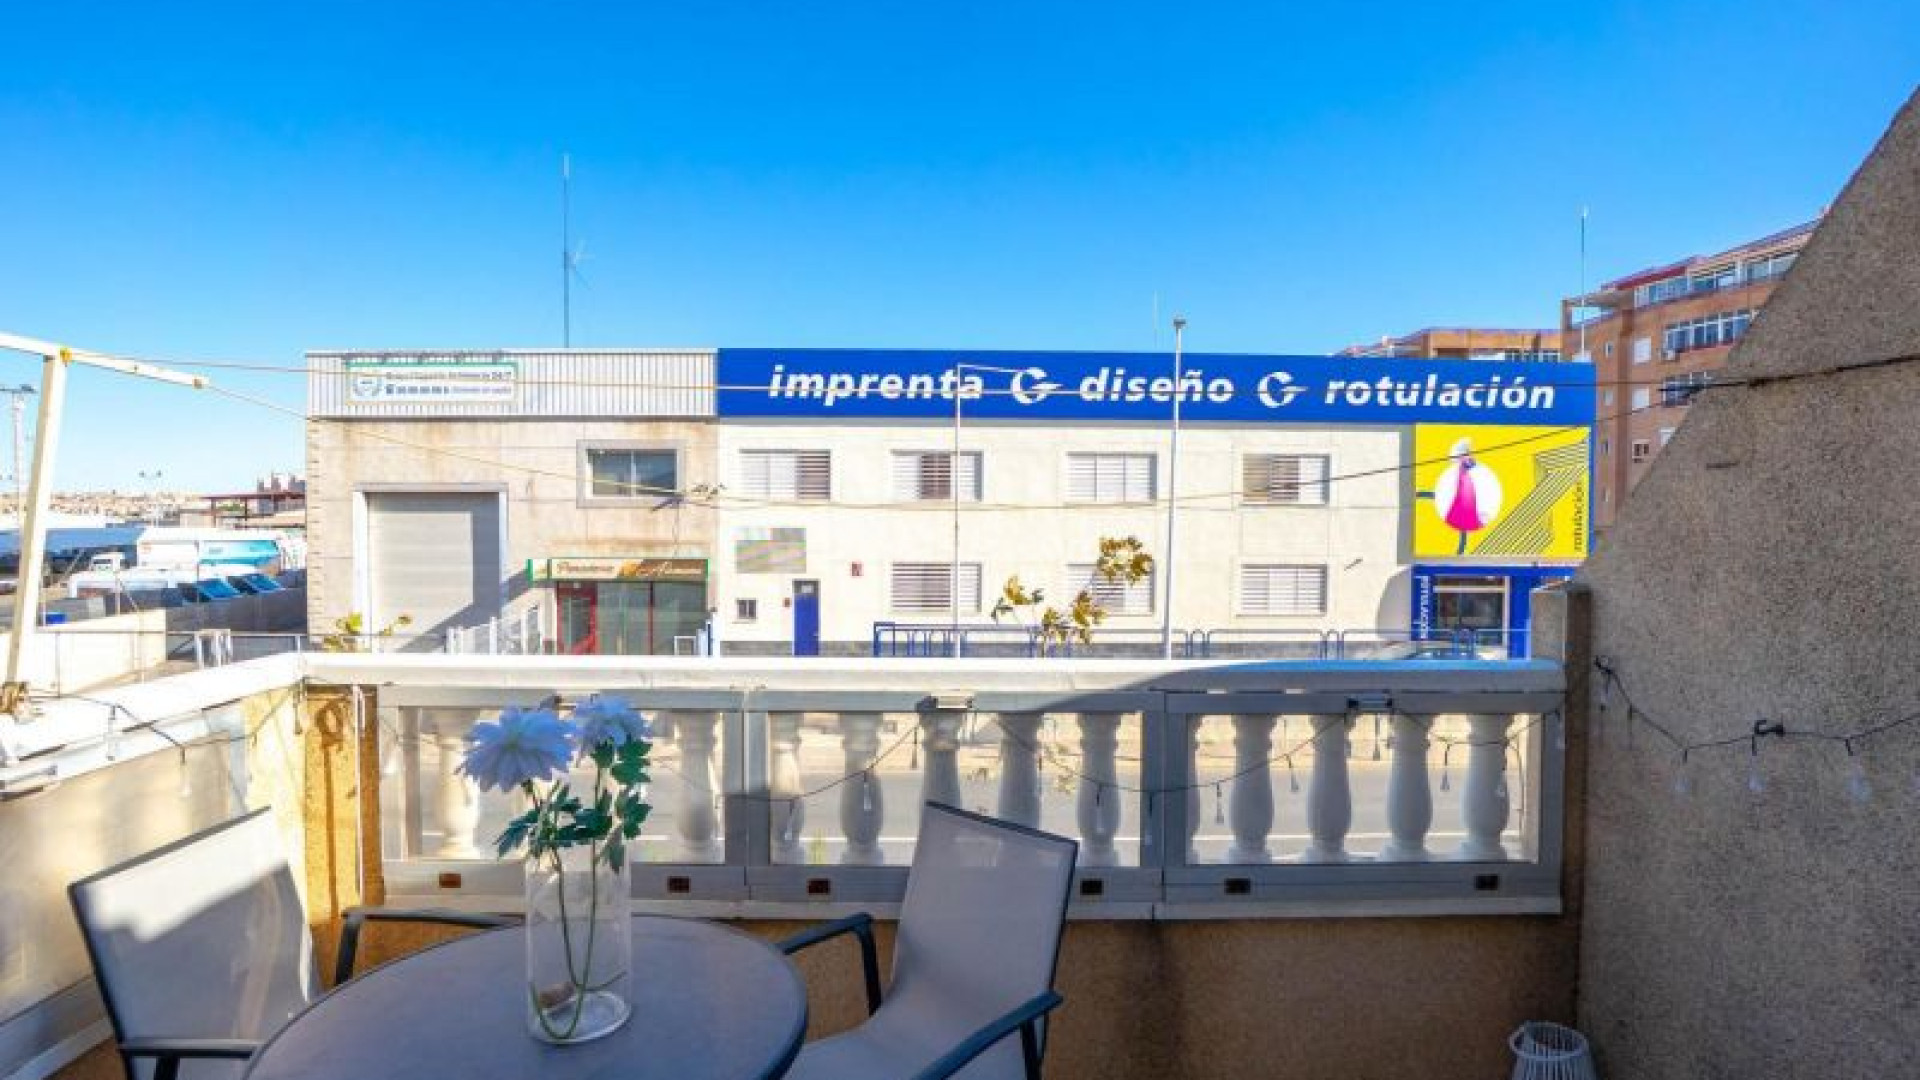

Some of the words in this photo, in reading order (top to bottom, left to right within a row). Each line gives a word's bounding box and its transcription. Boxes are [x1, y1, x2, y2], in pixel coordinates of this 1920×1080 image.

[769, 364, 984, 406] imprenta
[1079, 367, 1235, 402] diseño
[1324, 373, 1556, 409] rotulación
